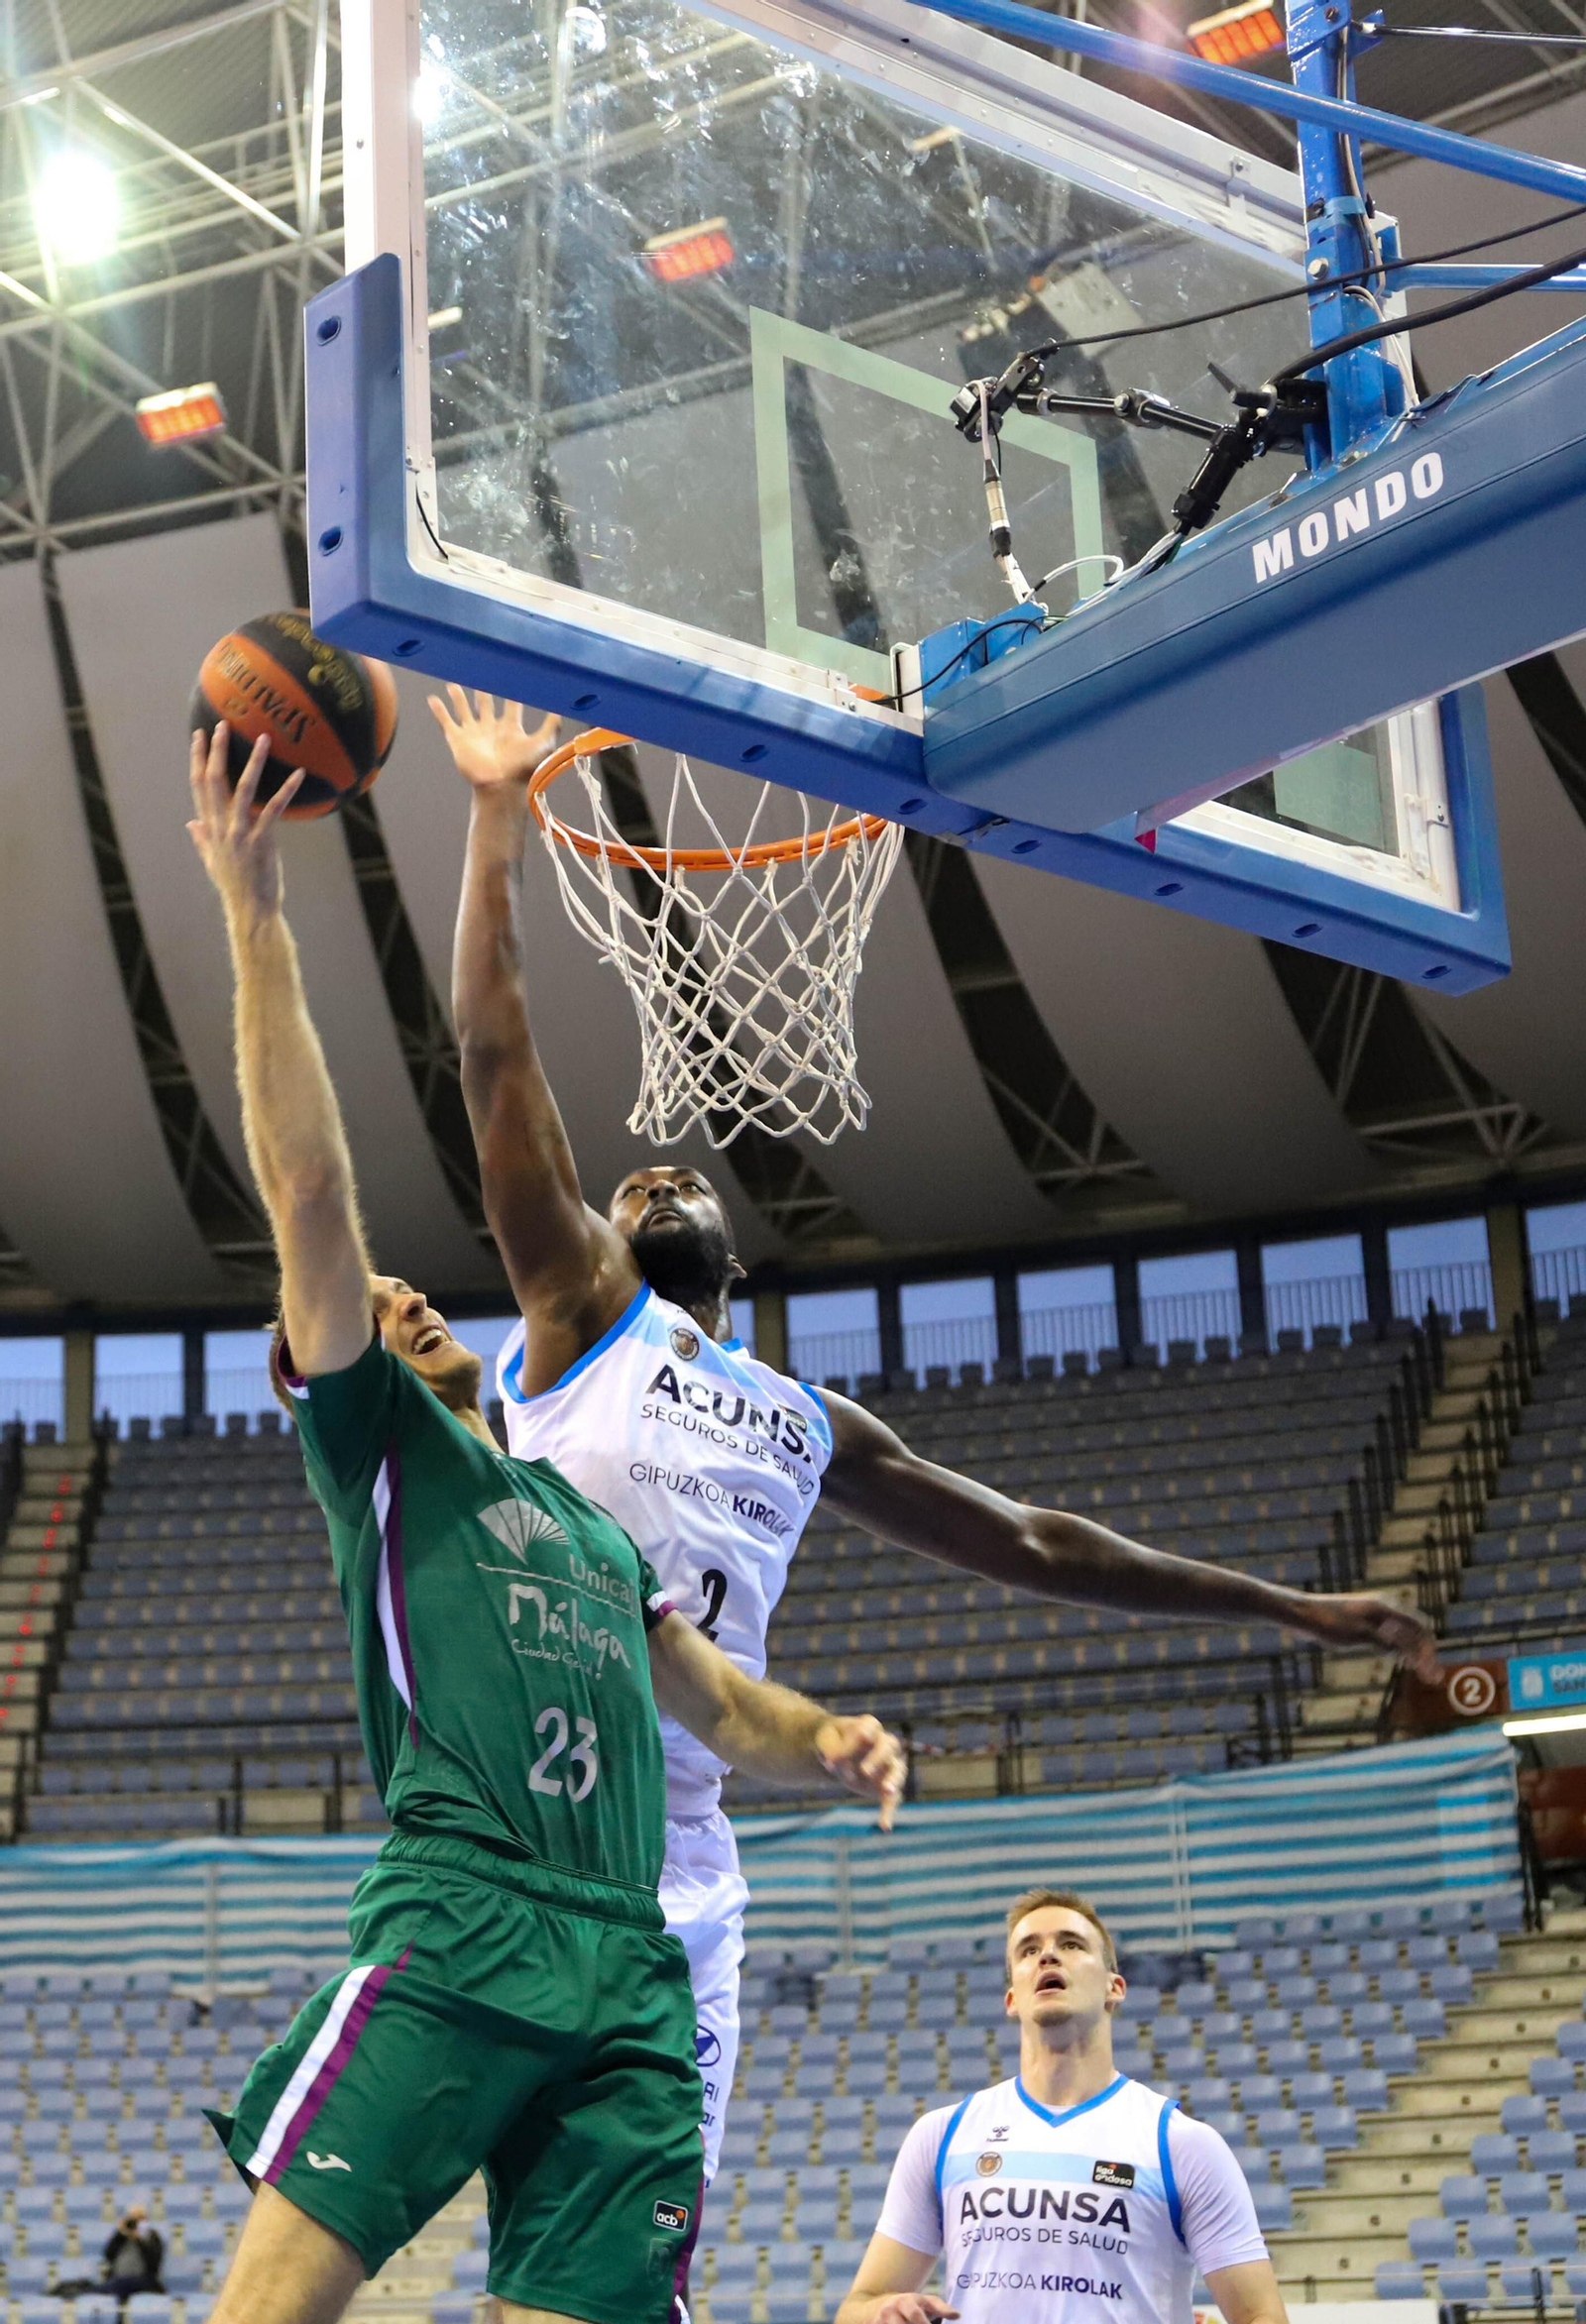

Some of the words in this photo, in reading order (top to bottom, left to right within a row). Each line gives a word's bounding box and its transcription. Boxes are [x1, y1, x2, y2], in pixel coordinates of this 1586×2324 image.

[1252, 452, 1444, 584] MONDO
[640, 1403, 737, 1449] SEGUROS
[745, 1441, 768, 1462] DE
[697, 1568, 728, 1642] 2
[1462, 1677, 1482, 1705] 2
[527, 1707, 598, 1803] 23
[1094, 2173, 1132, 2186] endesa
[1096, 2165, 1114, 2174] liga
[656, 2212, 678, 2227] acb
[960, 2187, 1131, 2234] ACUNSA
[1038, 2228, 1062, 2245] DE
[1069, 2230, 1128, 2255] SALUD
[1042, 2274, 1123, 2299] KIROLAK
